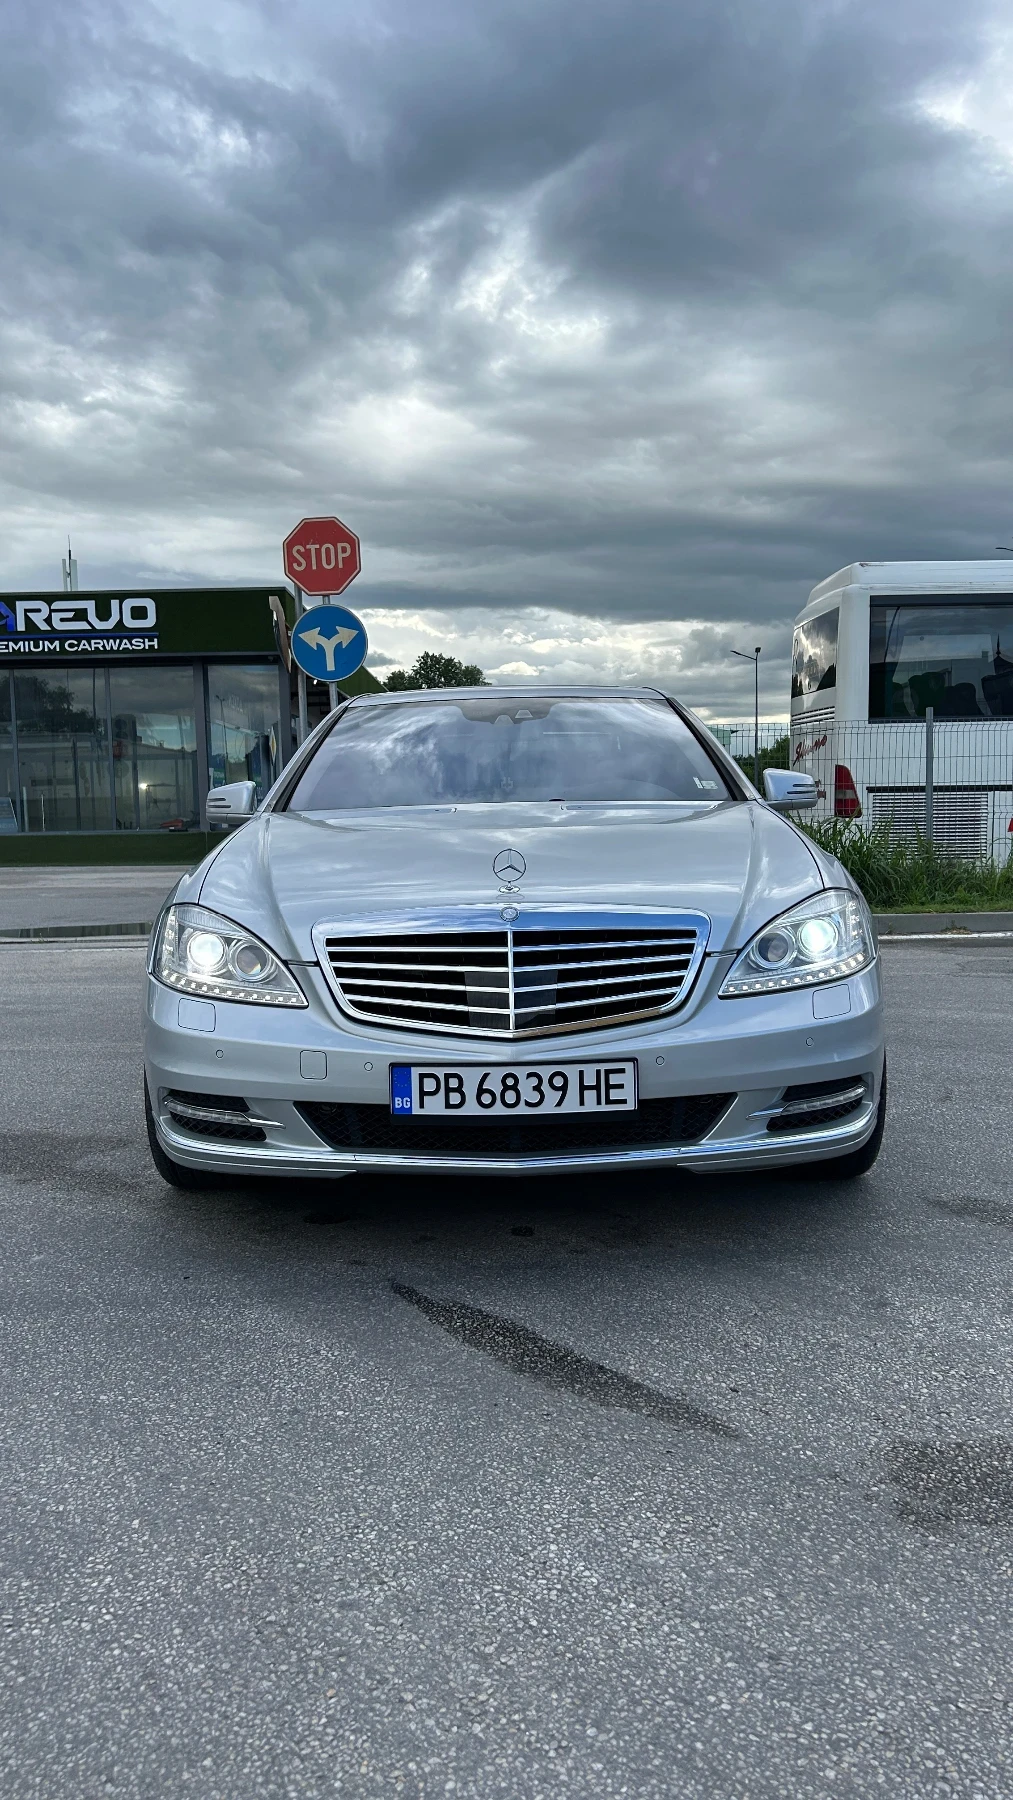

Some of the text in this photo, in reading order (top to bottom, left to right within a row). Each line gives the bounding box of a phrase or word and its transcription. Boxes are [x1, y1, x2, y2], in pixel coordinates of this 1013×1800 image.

[292, 542, 352, 571] STOP
[64, 638, 158, 651] CARWASH
[418, 1067, 628, 1110] PB 6839 HE
[394, 1097, 411, 1109] BG
